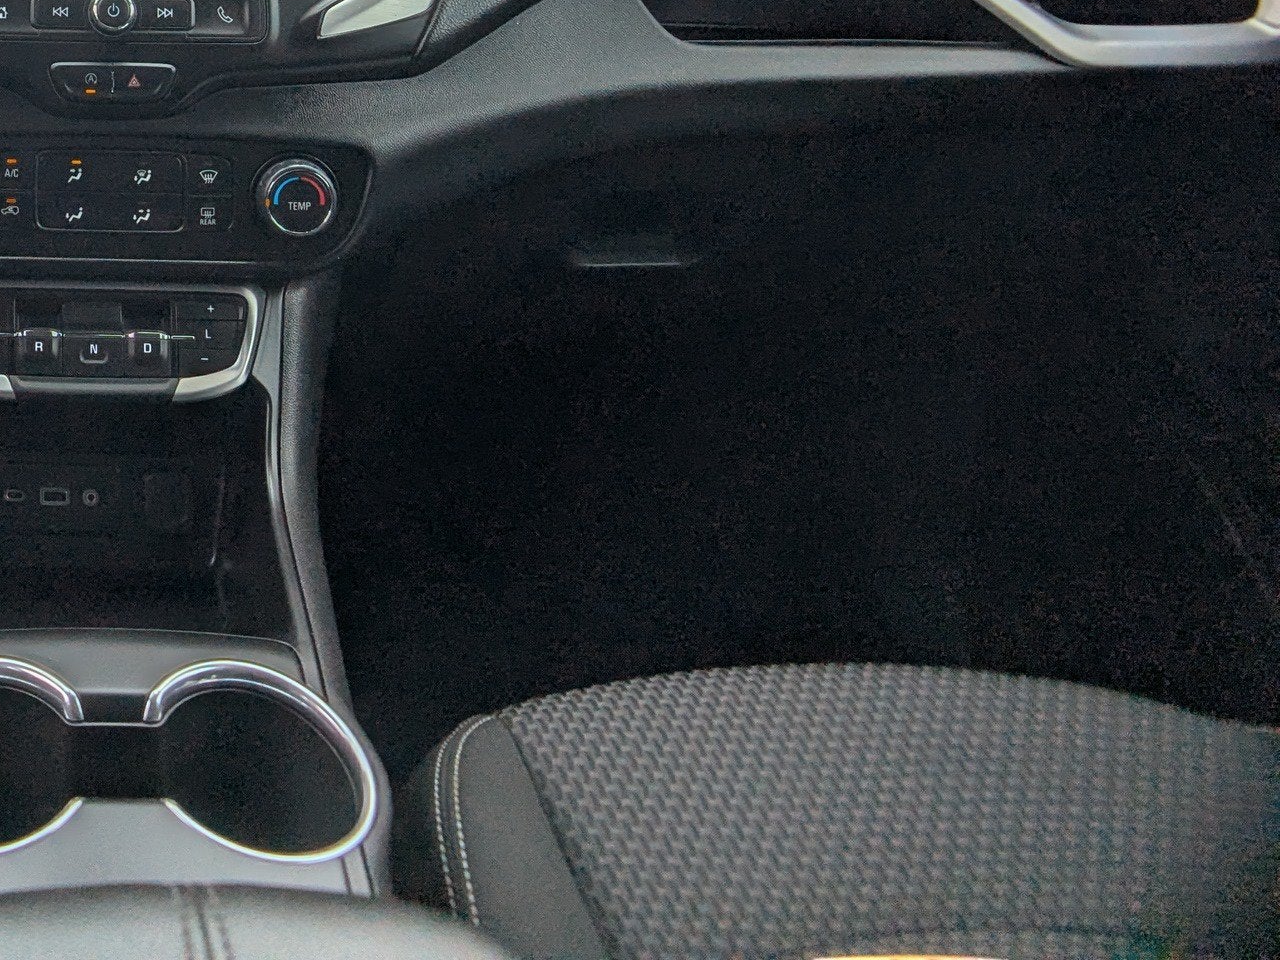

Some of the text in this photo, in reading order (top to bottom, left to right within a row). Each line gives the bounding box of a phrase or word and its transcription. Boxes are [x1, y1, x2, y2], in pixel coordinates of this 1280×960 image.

[4, 168, 19, 178] A/C
[288, 201, 312, 211] TEMP
[199, 218, 216, 226] REAR
[34, 328, 212, 355] R N D L
